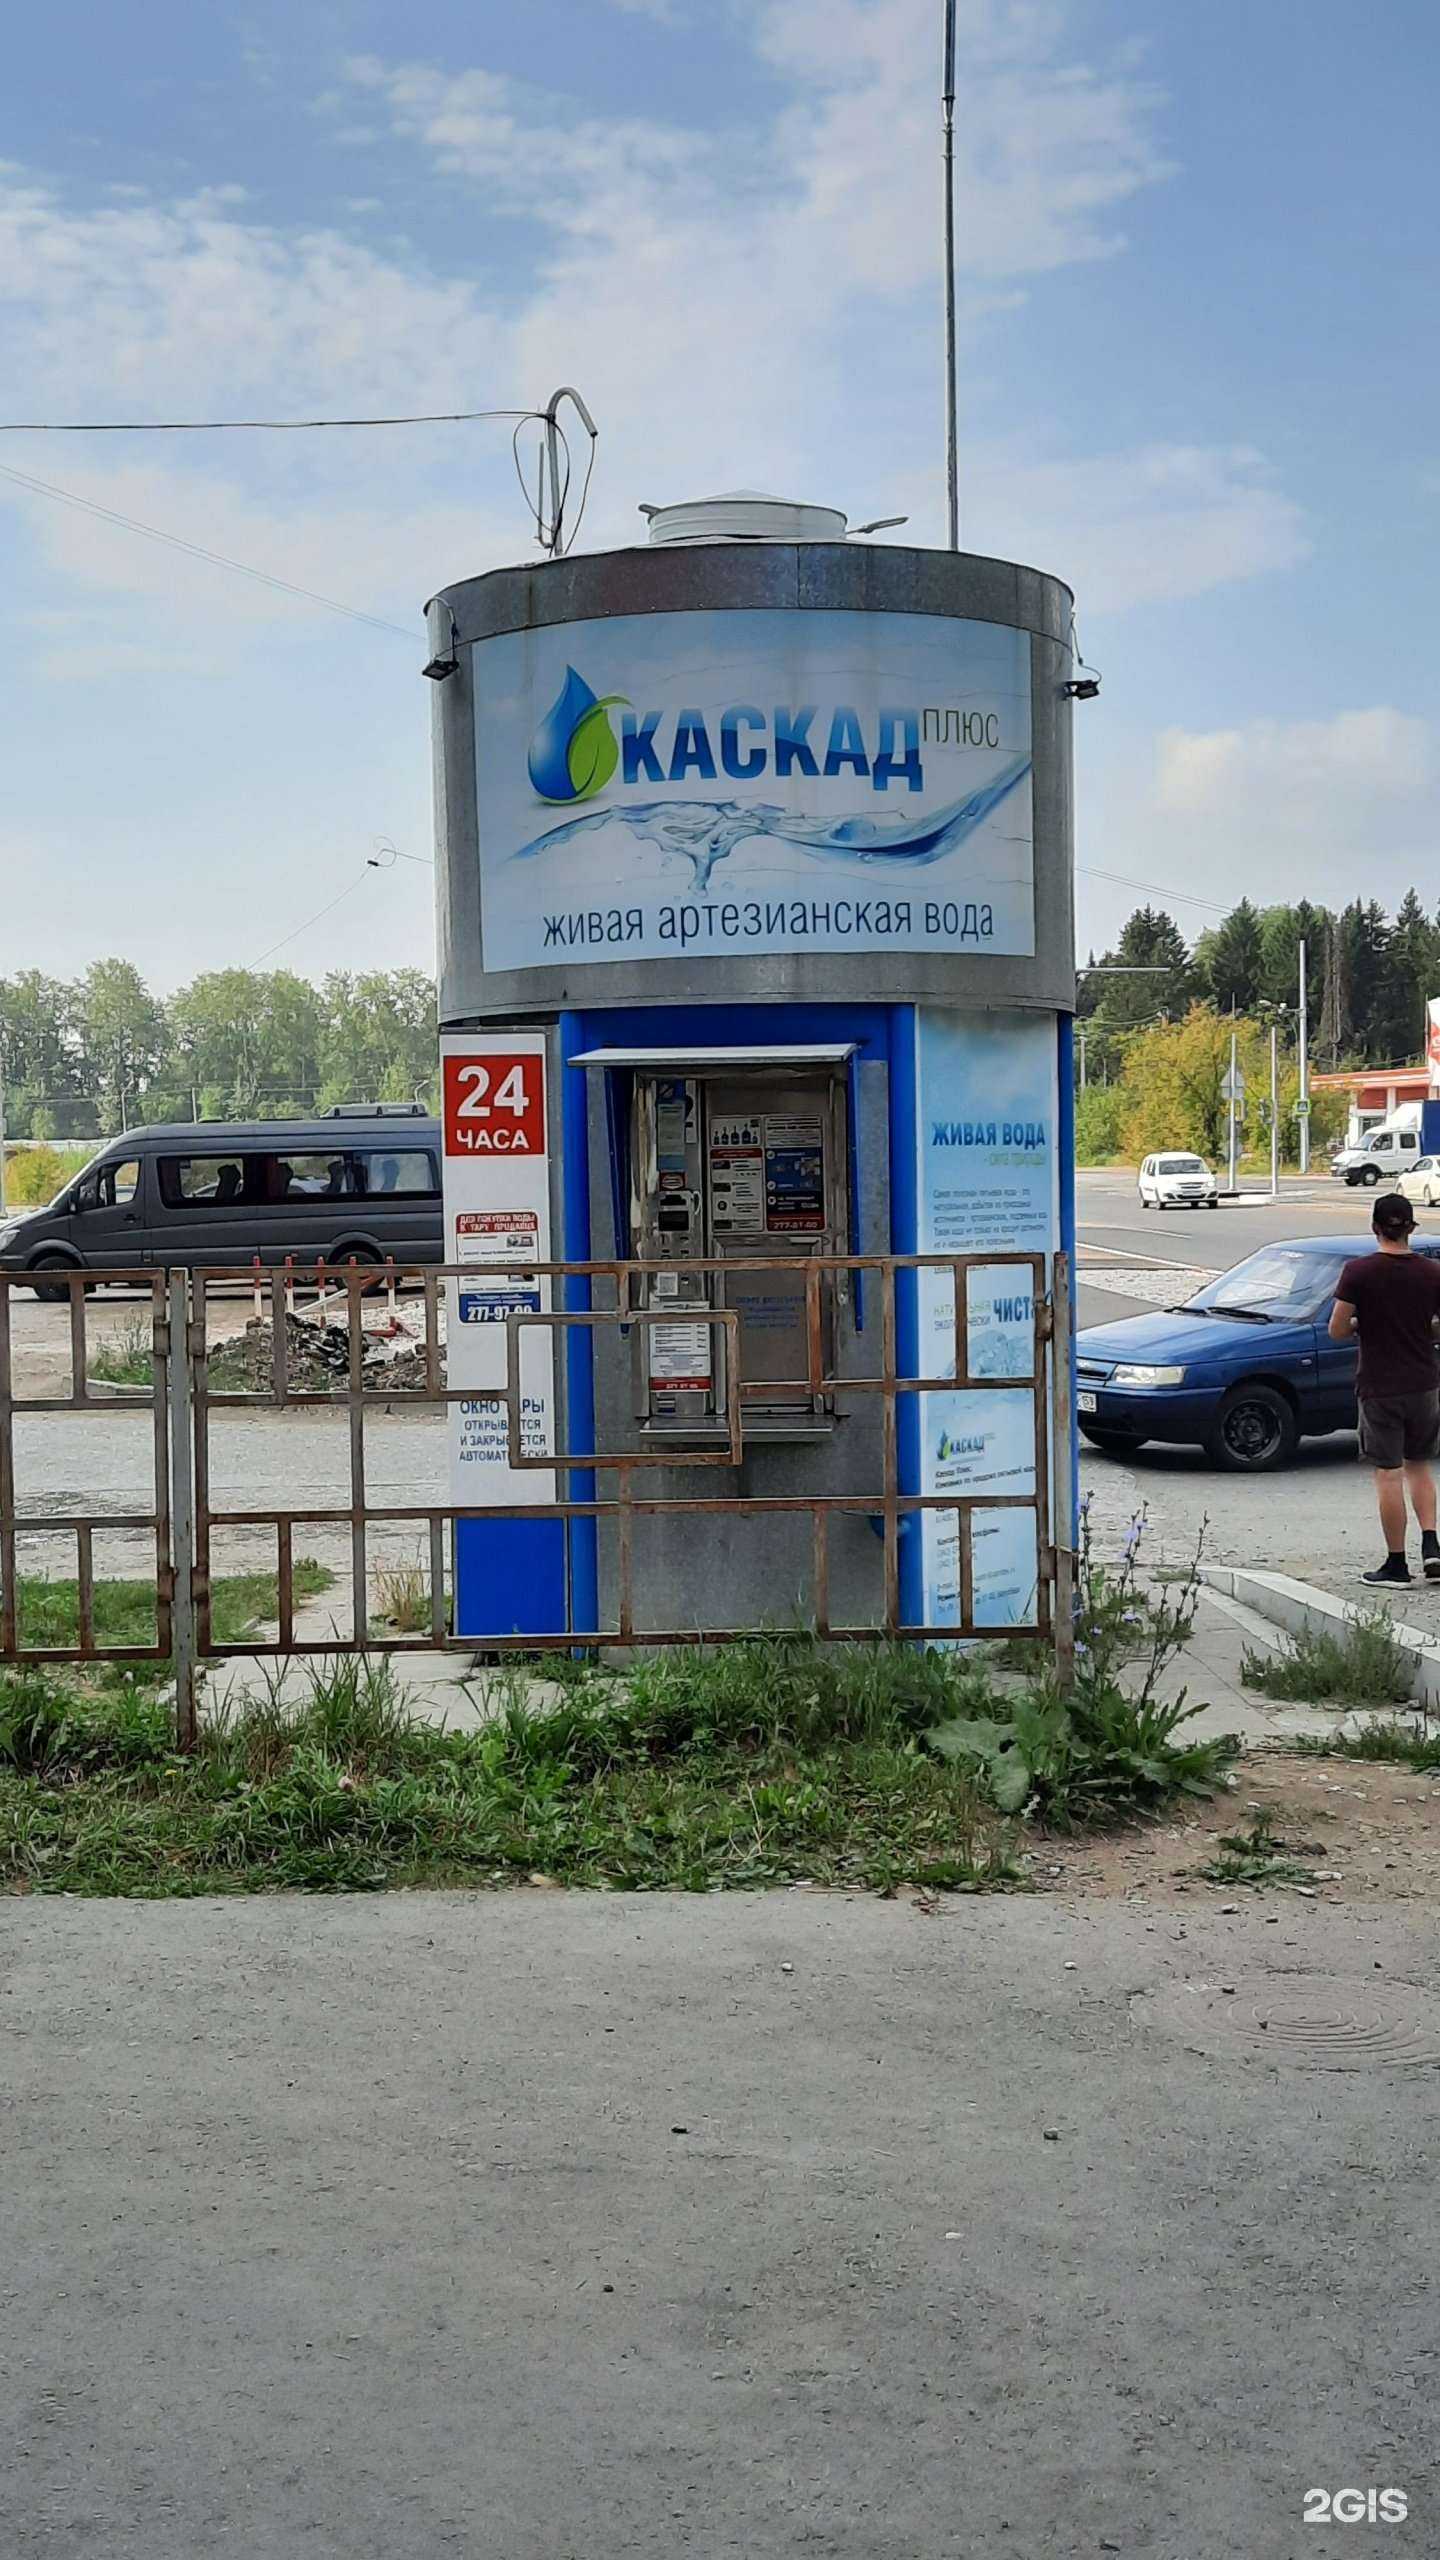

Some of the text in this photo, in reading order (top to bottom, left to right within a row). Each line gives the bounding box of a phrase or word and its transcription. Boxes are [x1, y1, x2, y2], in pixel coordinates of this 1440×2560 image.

[922, 708, 999, 749] ПЛЮС
[620, 706, 923, 792] КАСКАД
[543, 899, 994, 947] живая артезианская вода
[457, 1065, 530, 1117] 24
[456, 1129, 530, 1149] ЧАСА
[932, 1121, 1046, 1150] ЖИВАЯ ВОДА
[993, 1296, 1035, 1323] ЧИСТ
[460, 1400, 500, 1414] ОКНО
[464, 1419, 541, 1431] ОТКРЫВТСЯ
[460, 1434, 546, 1446] И ЗАКРЫВЕТСЯ
[460, 1449, 549, 1461] АВТОМАТЕСКИ
